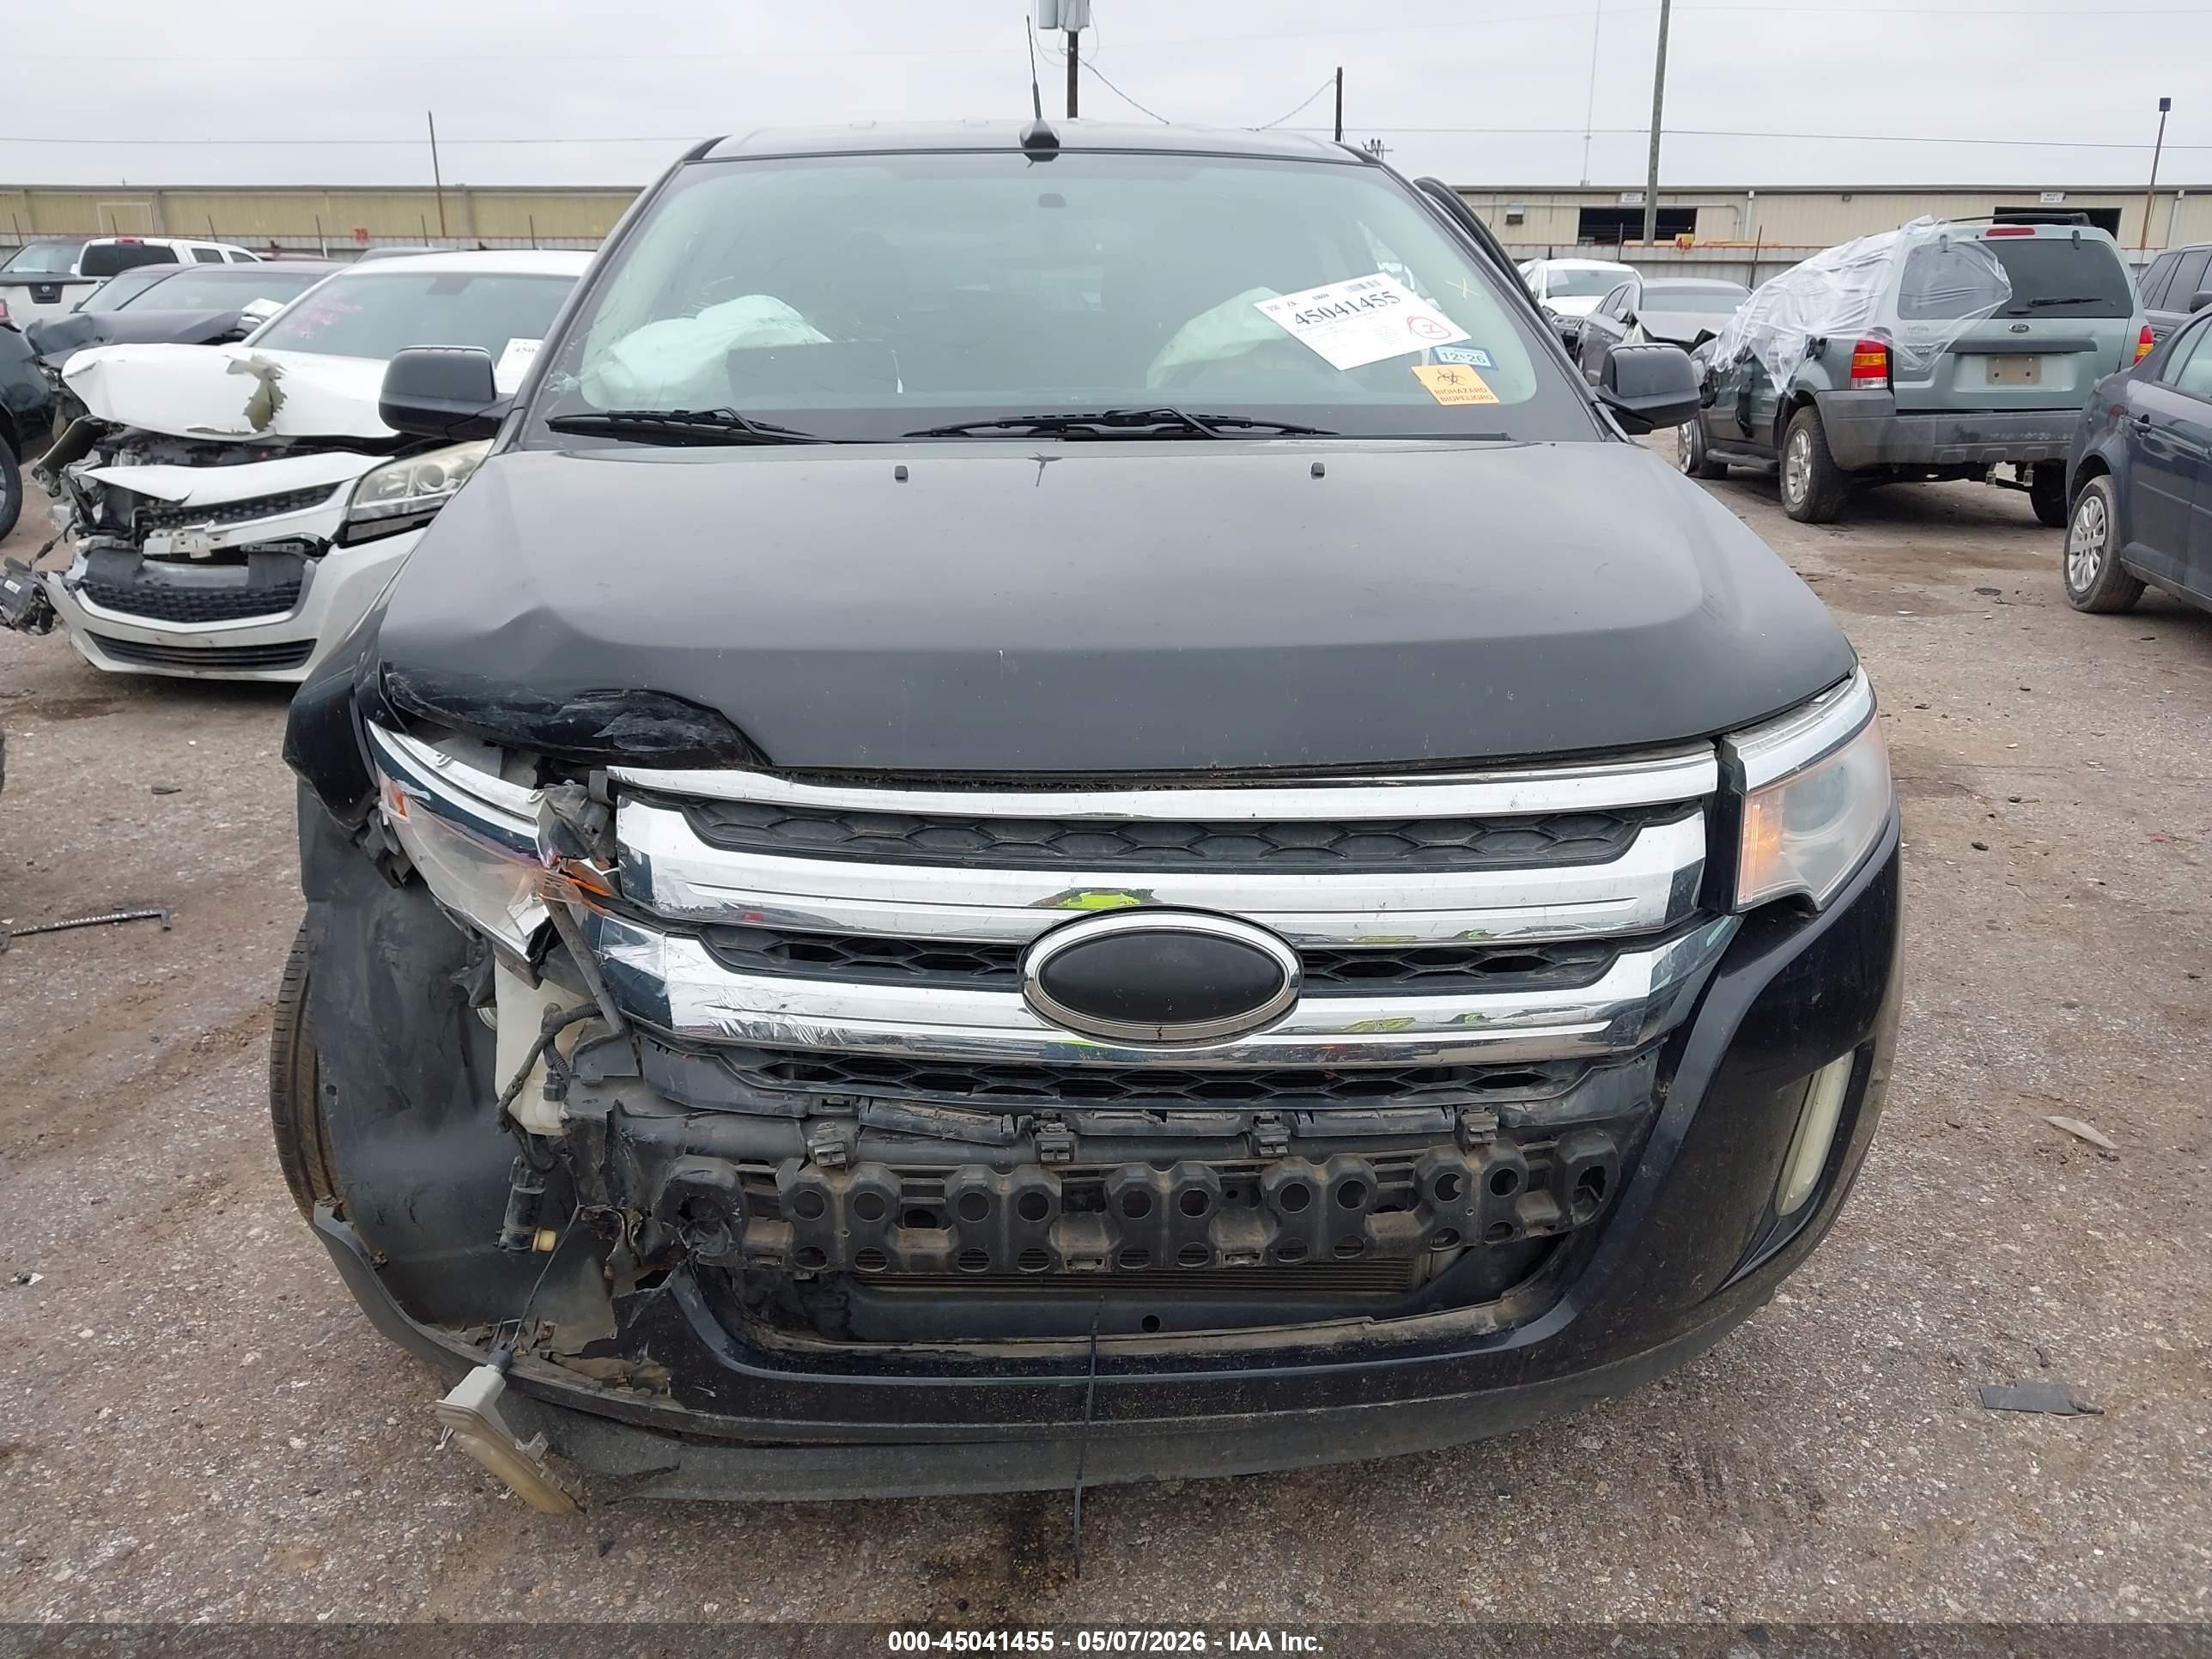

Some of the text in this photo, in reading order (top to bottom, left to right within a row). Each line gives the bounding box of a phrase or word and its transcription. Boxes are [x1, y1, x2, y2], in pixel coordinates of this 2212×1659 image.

[1295, 291, 1401, 325] 45041455
[1443, 352, 1486, 364] 12 26
